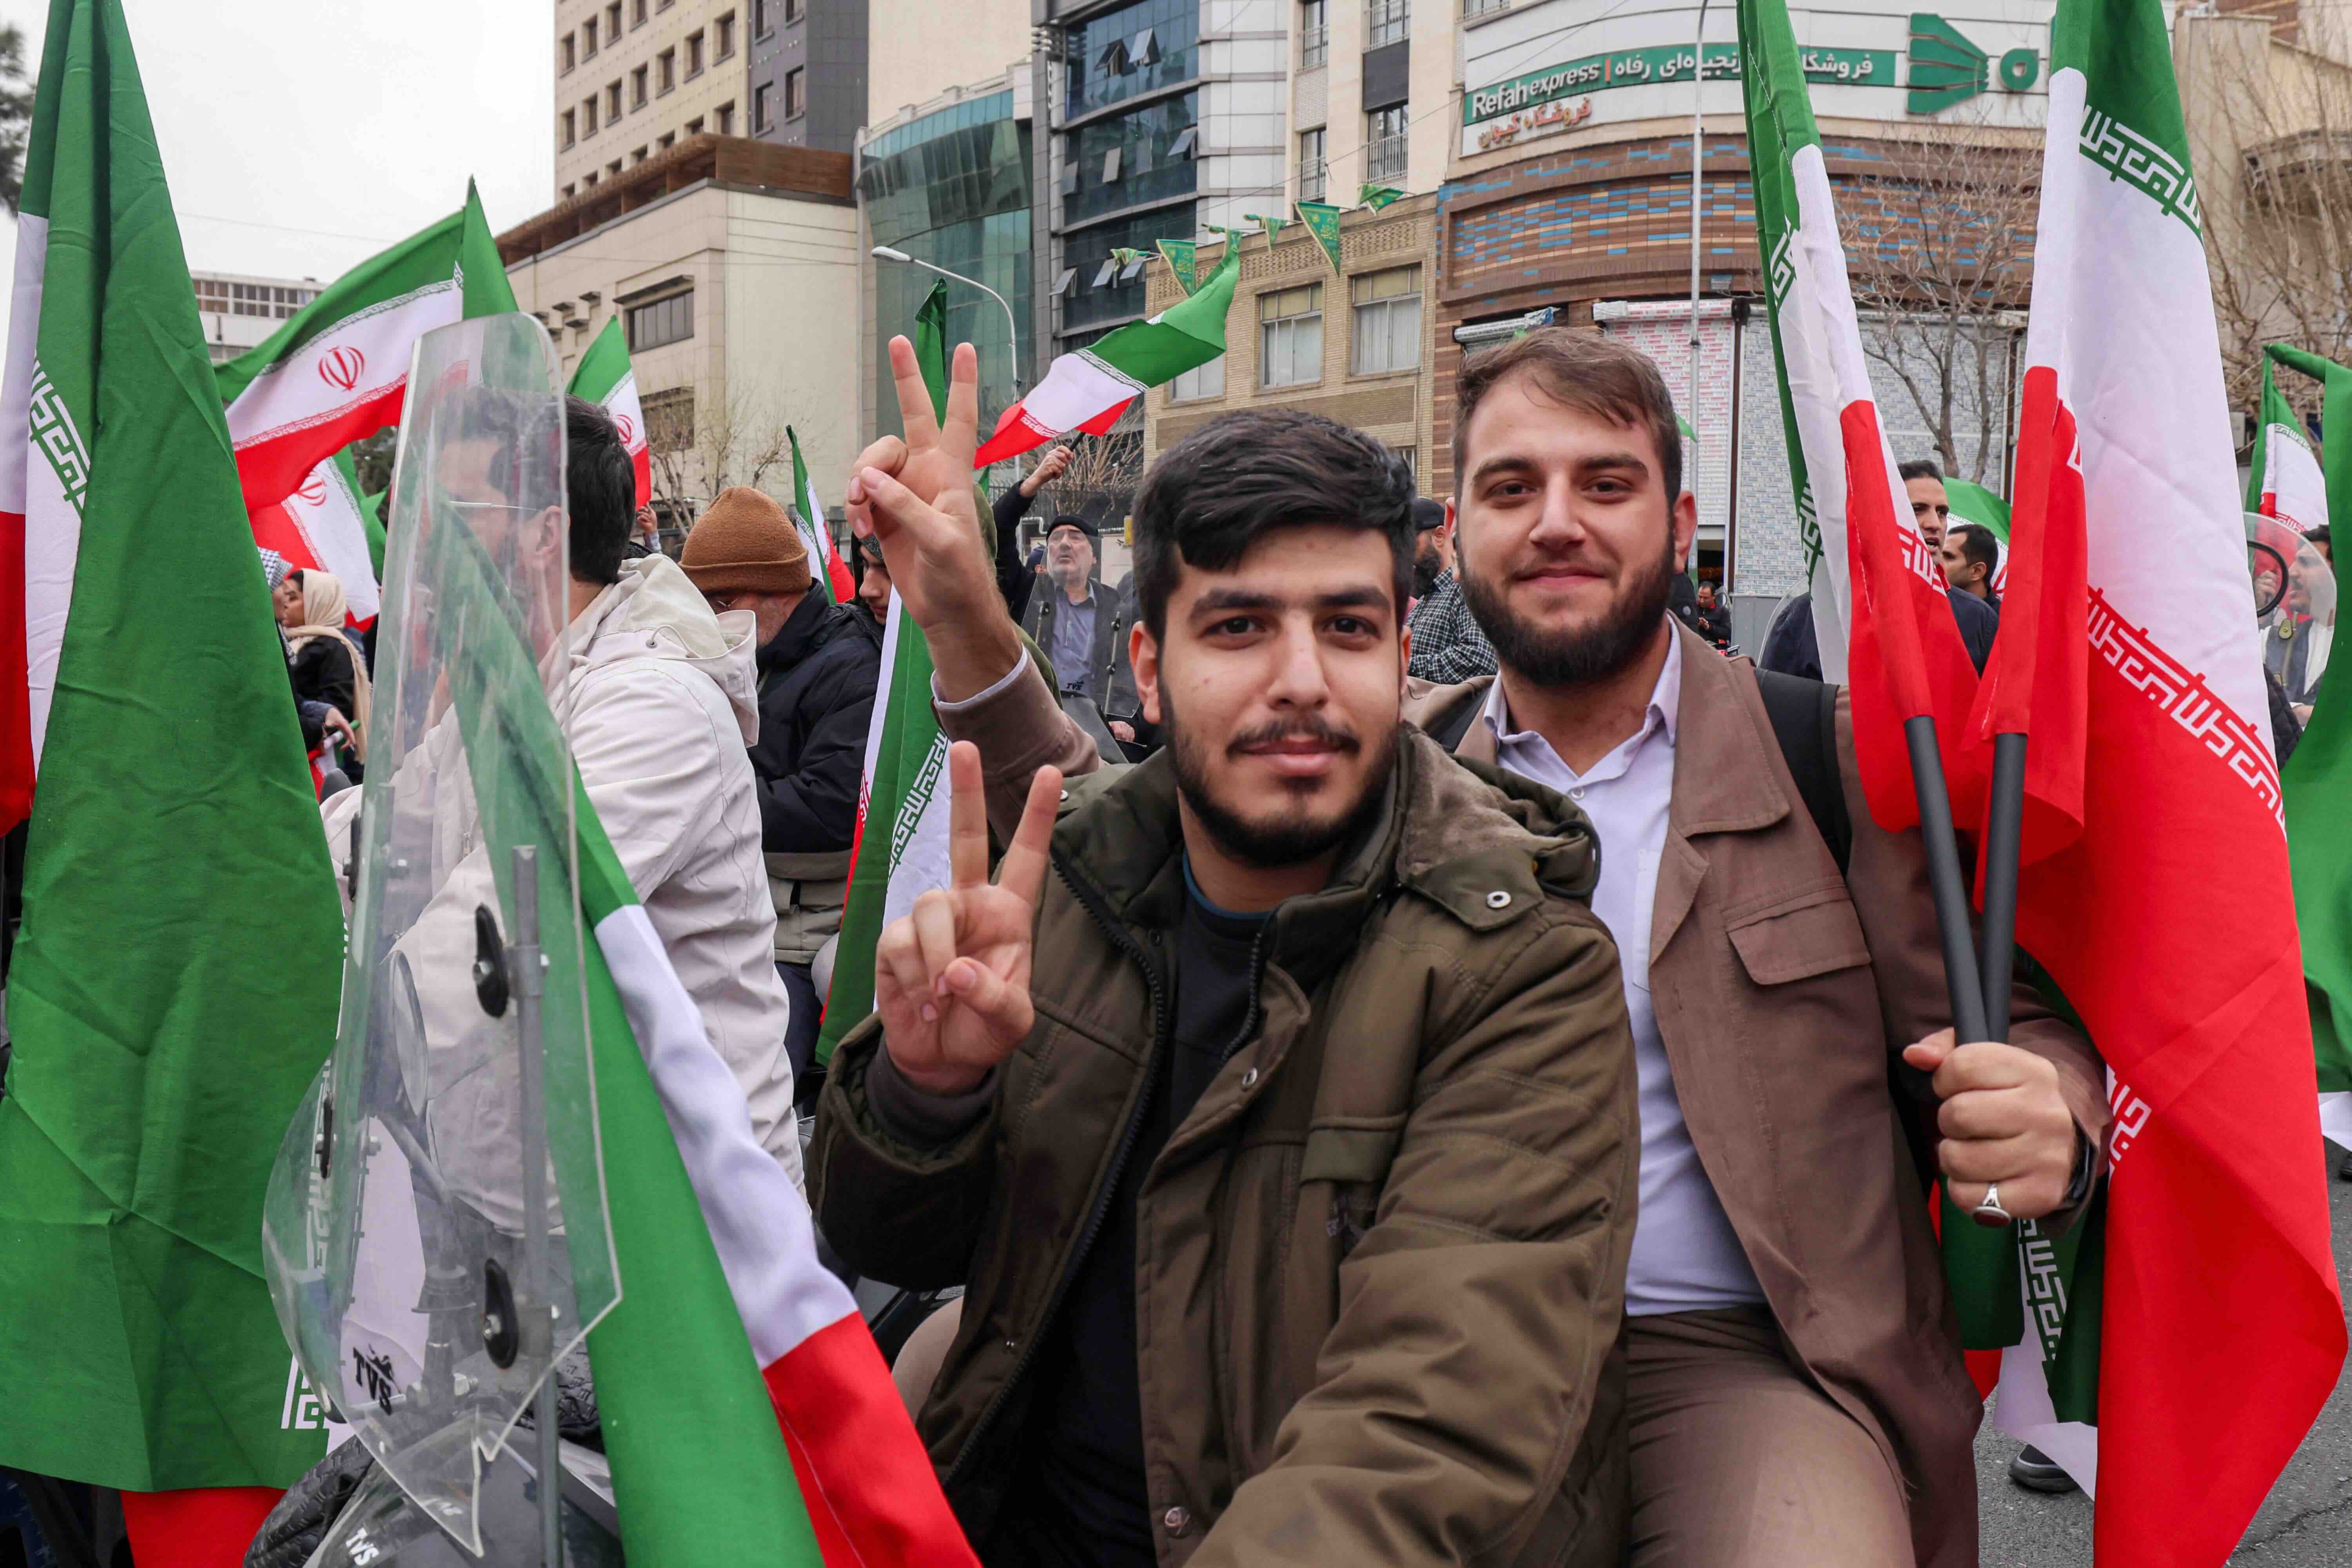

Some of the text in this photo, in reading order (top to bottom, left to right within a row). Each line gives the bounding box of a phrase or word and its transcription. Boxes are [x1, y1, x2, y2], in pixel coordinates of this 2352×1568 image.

[1615, 54, 1651, 79] رفاه
[1802, 51, 1873, 79] فروشگا
[1472, 62, 1601, 118] Refah express
[1524, 96, 1592, 129] فروشگاه
[353, 1347, 392, 1416] TVS
[345, 1527, 379, 1566] TVS
